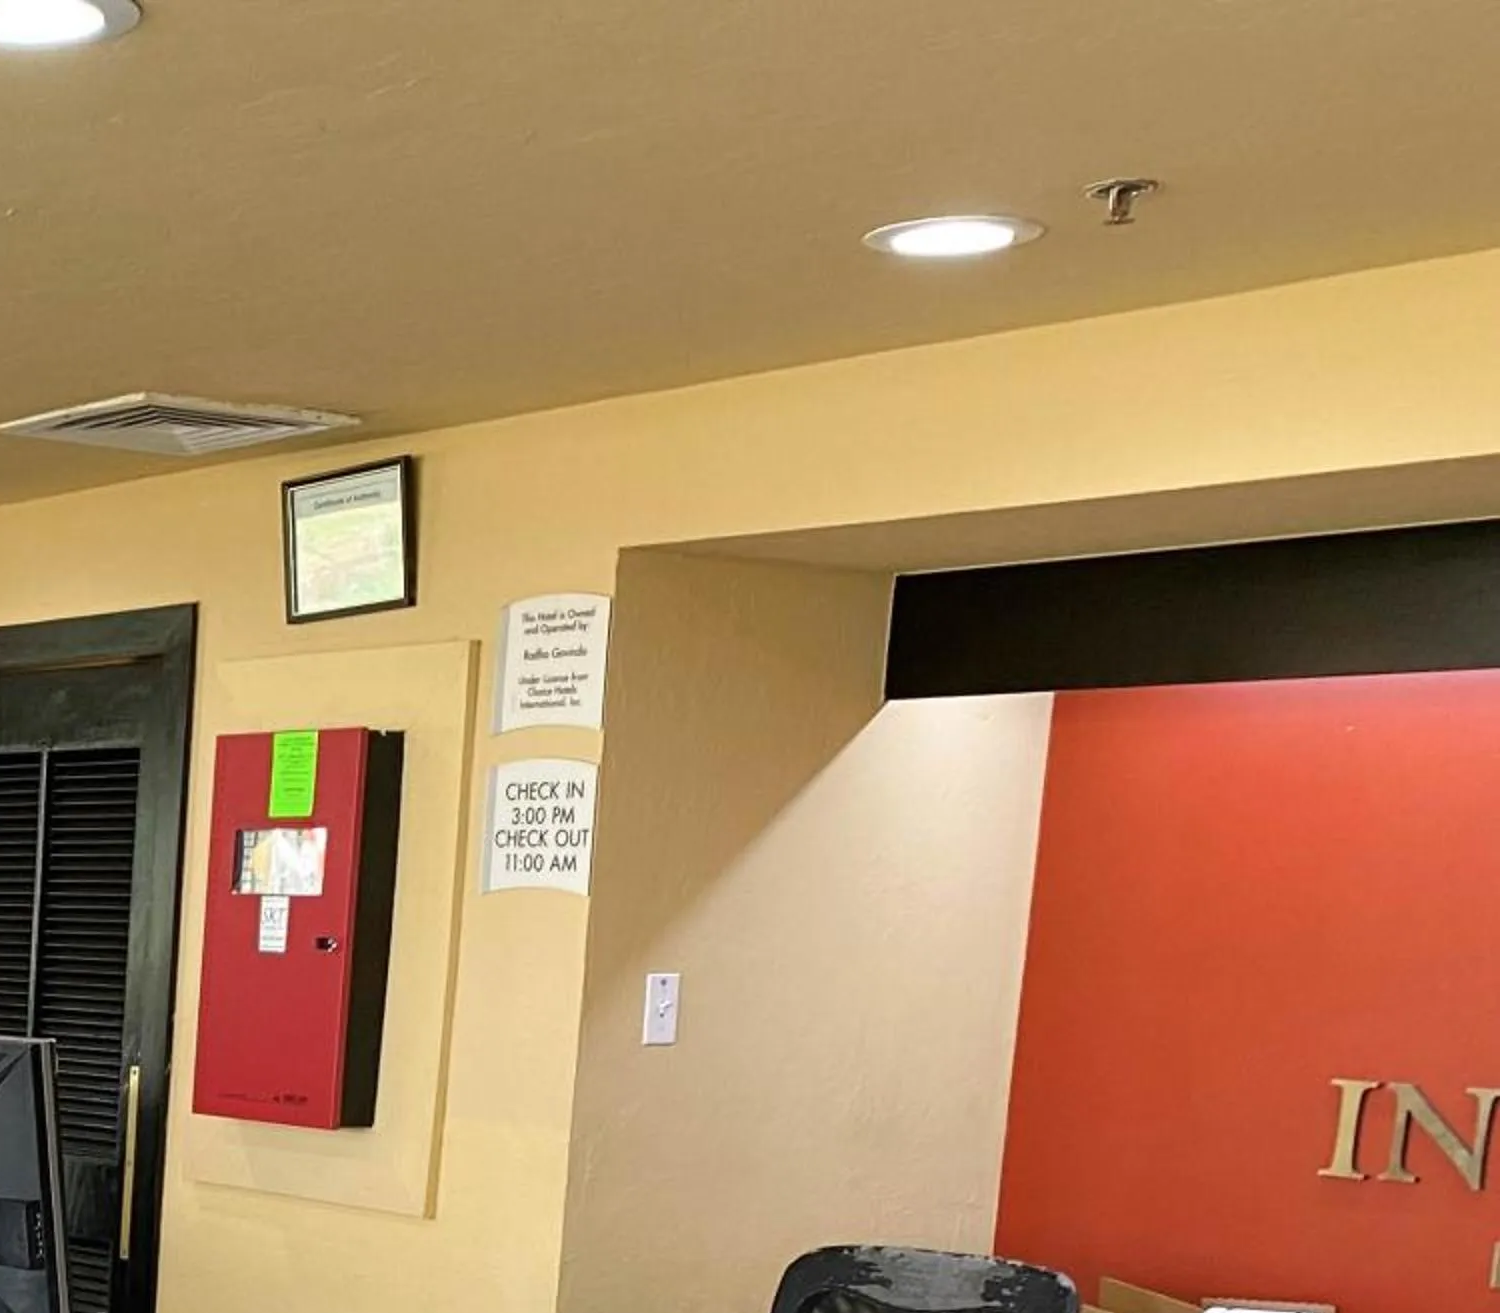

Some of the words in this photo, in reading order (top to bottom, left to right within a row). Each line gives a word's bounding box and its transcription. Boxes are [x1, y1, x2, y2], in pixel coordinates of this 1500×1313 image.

[567, 605, 596, 619] Owned
[505, 780, 560, 801] CHECK
[565, 779, 585, 799] IN
[511, 806, 546, 825] 3:00
[552, 806, 576, 824] PM
[495, 828, 549, 849] CHECK
[555, 828, 590, 848] OUT
[505, 853, 545, 872] 11:00
[549, 855, 577, 872] AM
